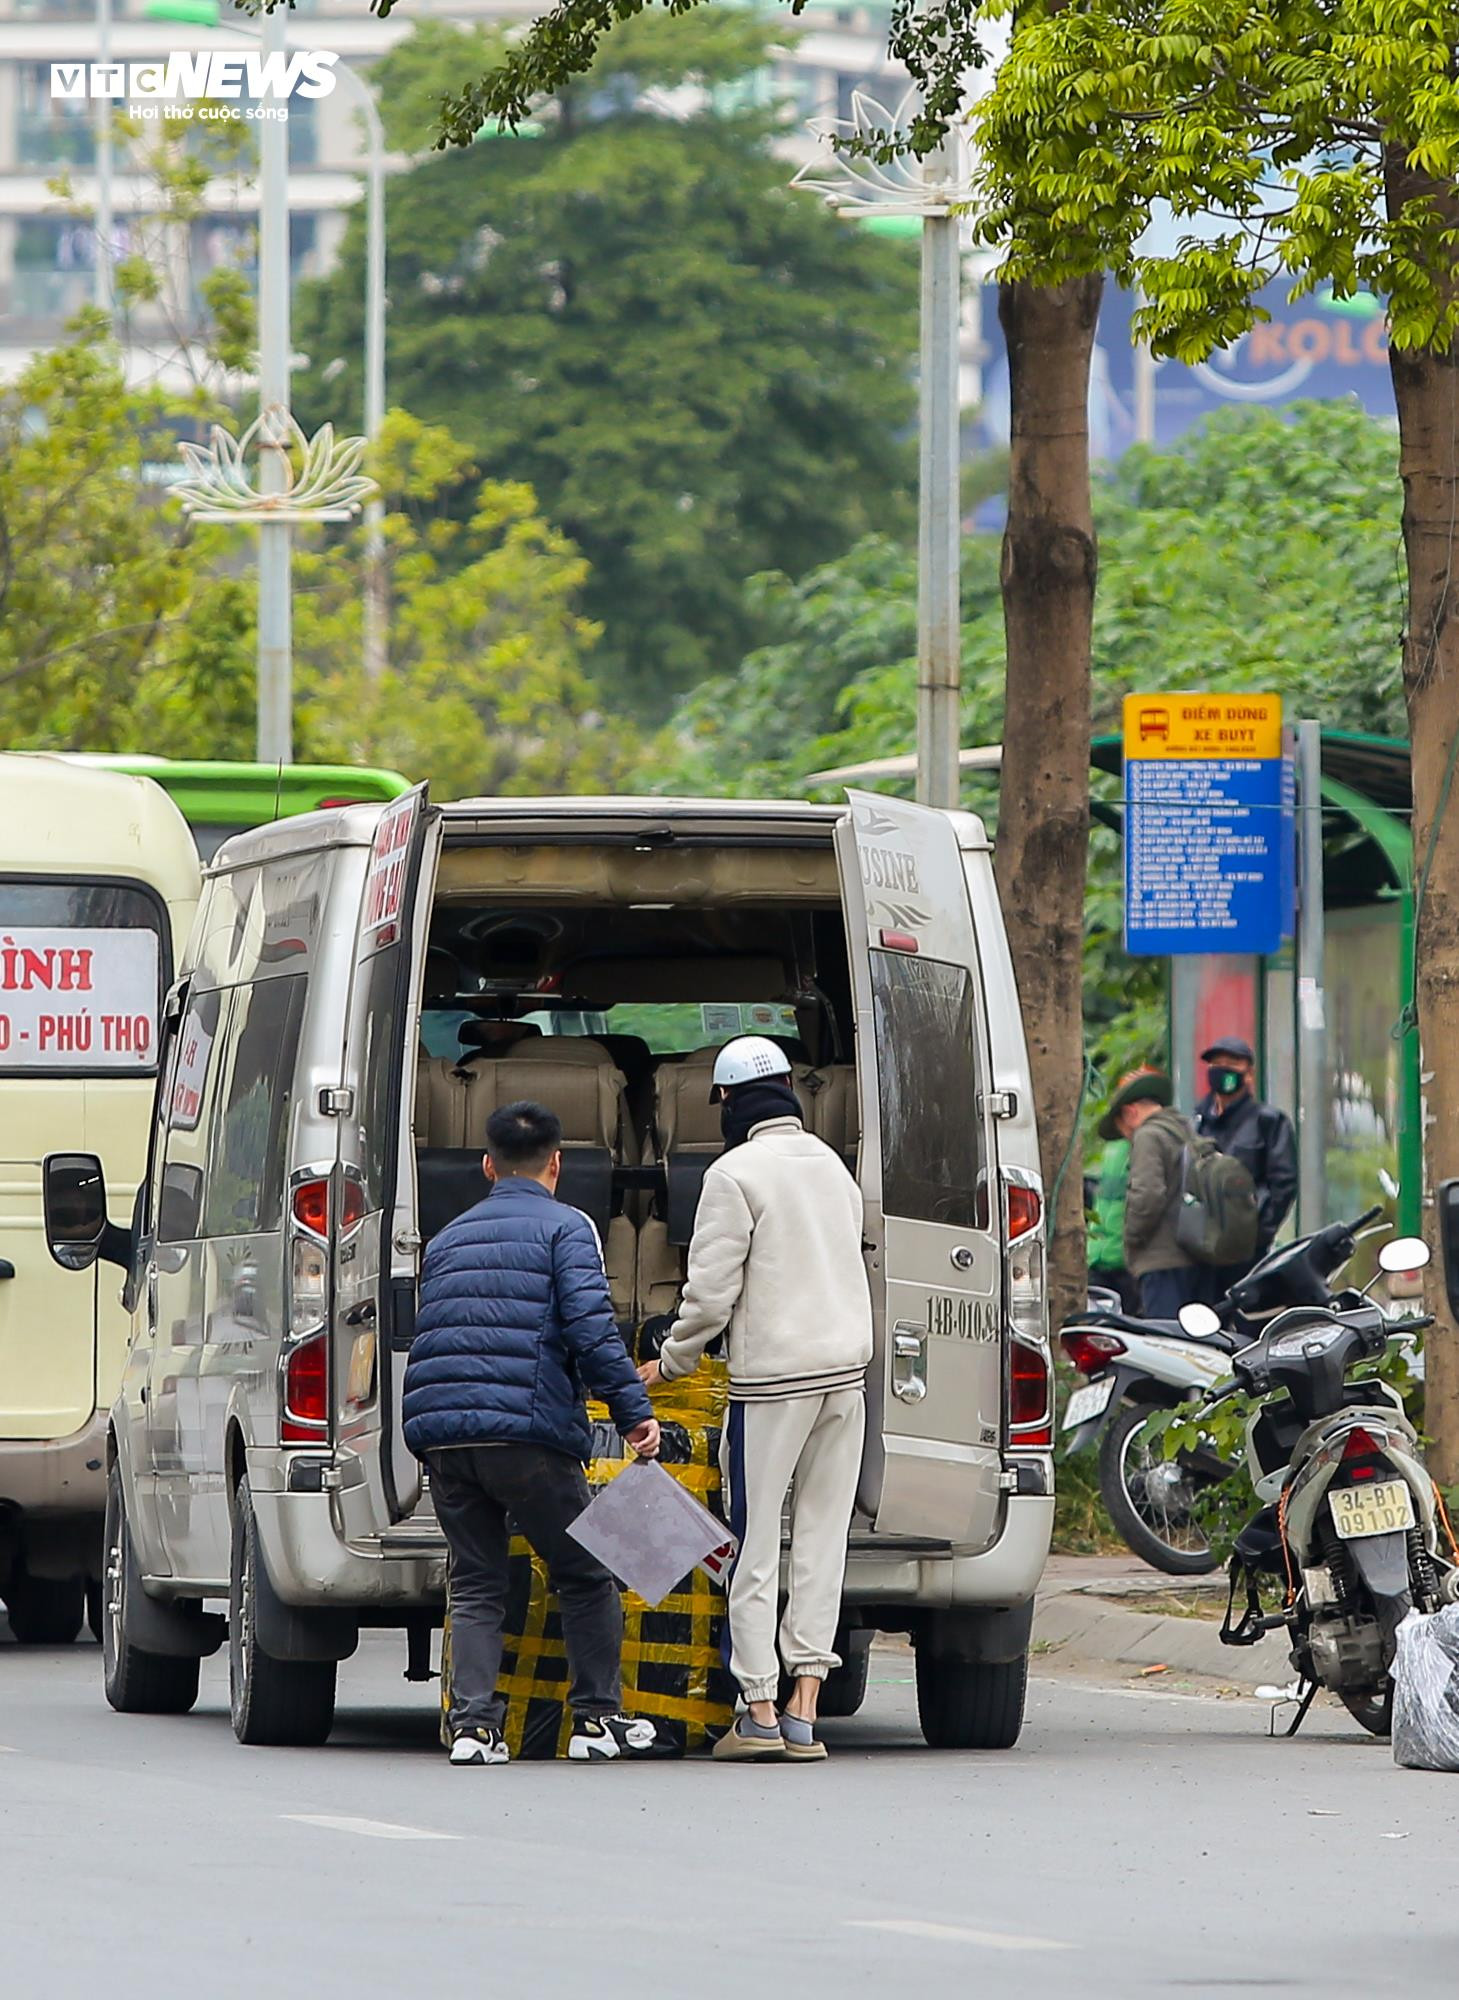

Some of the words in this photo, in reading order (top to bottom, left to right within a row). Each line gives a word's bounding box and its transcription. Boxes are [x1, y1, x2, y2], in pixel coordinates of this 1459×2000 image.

[1194, 728, 1213, 741] XE
[1, 936, 93, 990] ÌNH
[39, 1008, 91, 1051] PHÚ
[101, 1016, 149, 1060] THỌ
[1341, 1486, 1396, 1512] 34-B1
[1340, 1506, 1409, 1534] 091.02
